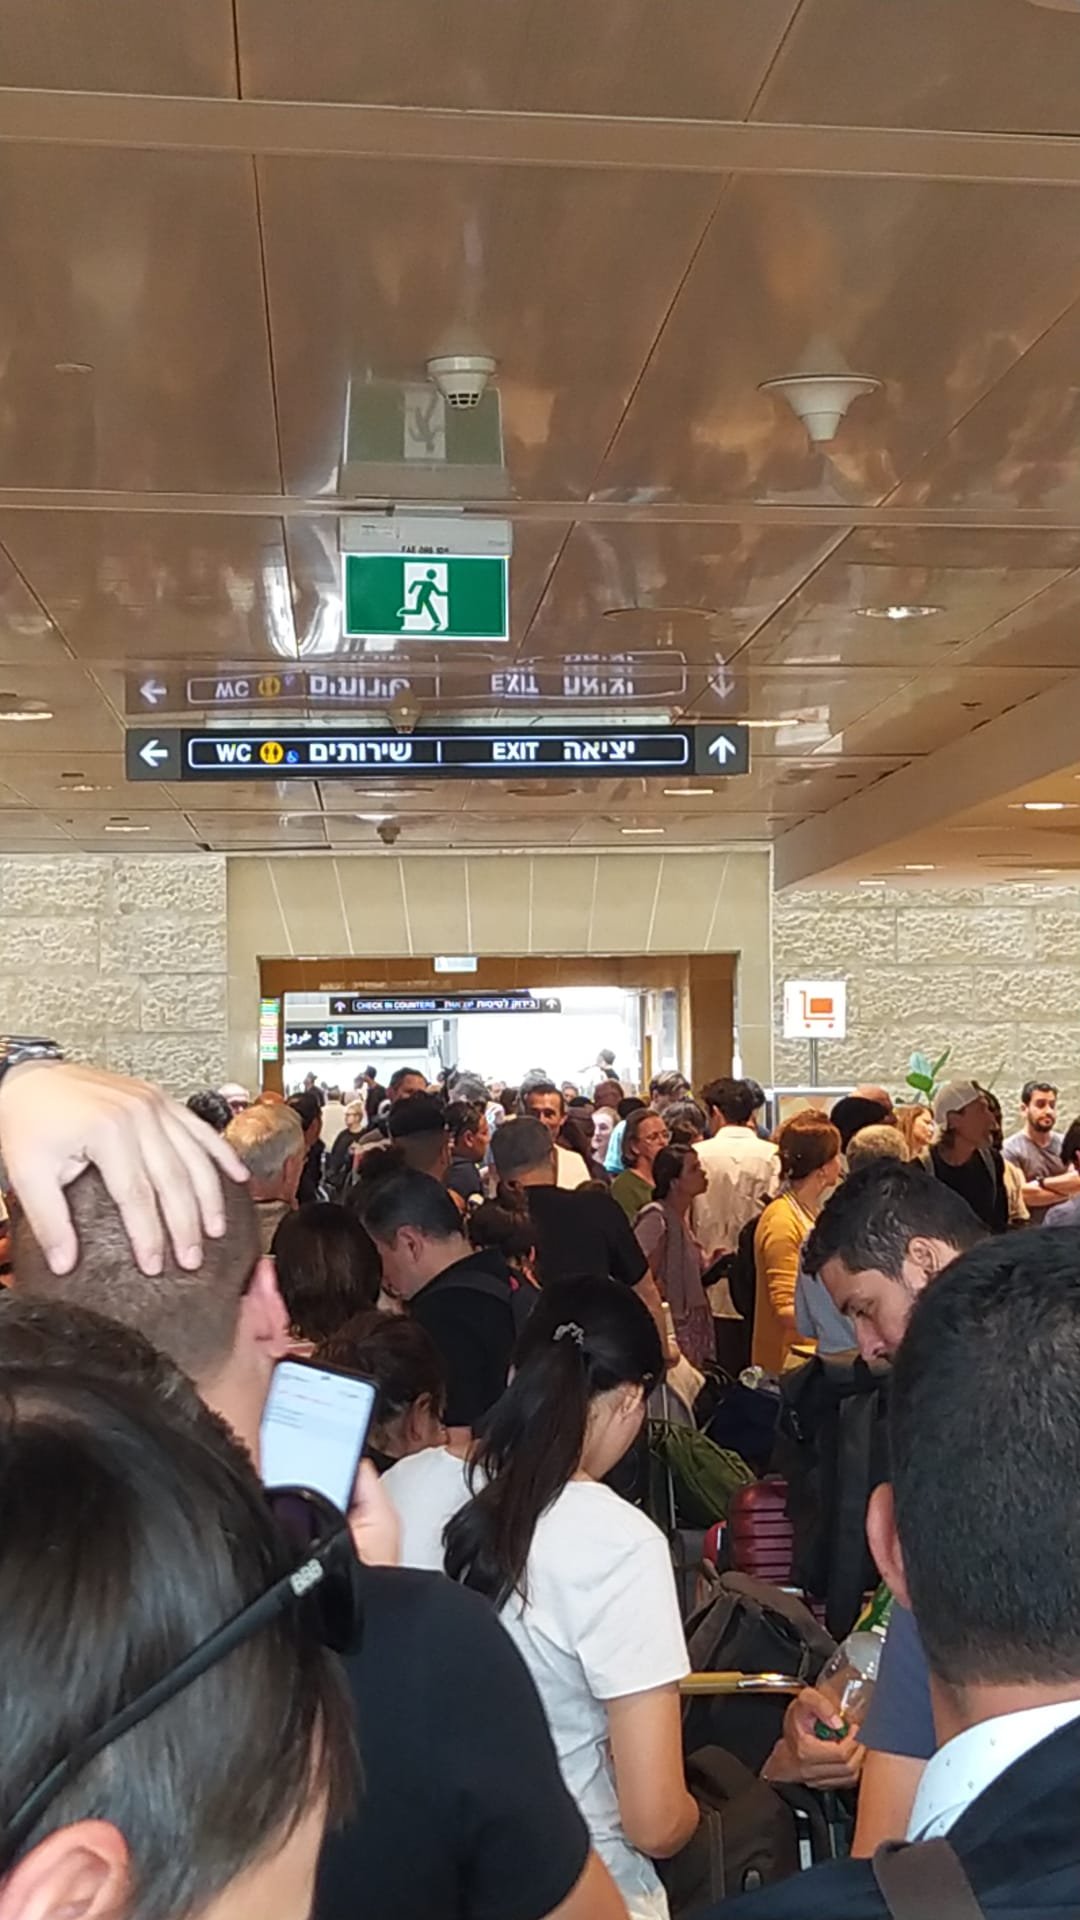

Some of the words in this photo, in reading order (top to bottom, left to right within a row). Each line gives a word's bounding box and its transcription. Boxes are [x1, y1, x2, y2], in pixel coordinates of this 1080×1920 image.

[216, 743, 252, 762] WC
[309, 742, 412, 762] שירותים
[492, 741, 539, 760] EXIT
[563, 740, 635, 760] יציאה
[356, 1001, 383, 1010] CHECK
[347, 1030, 392, 1046] יציאה
